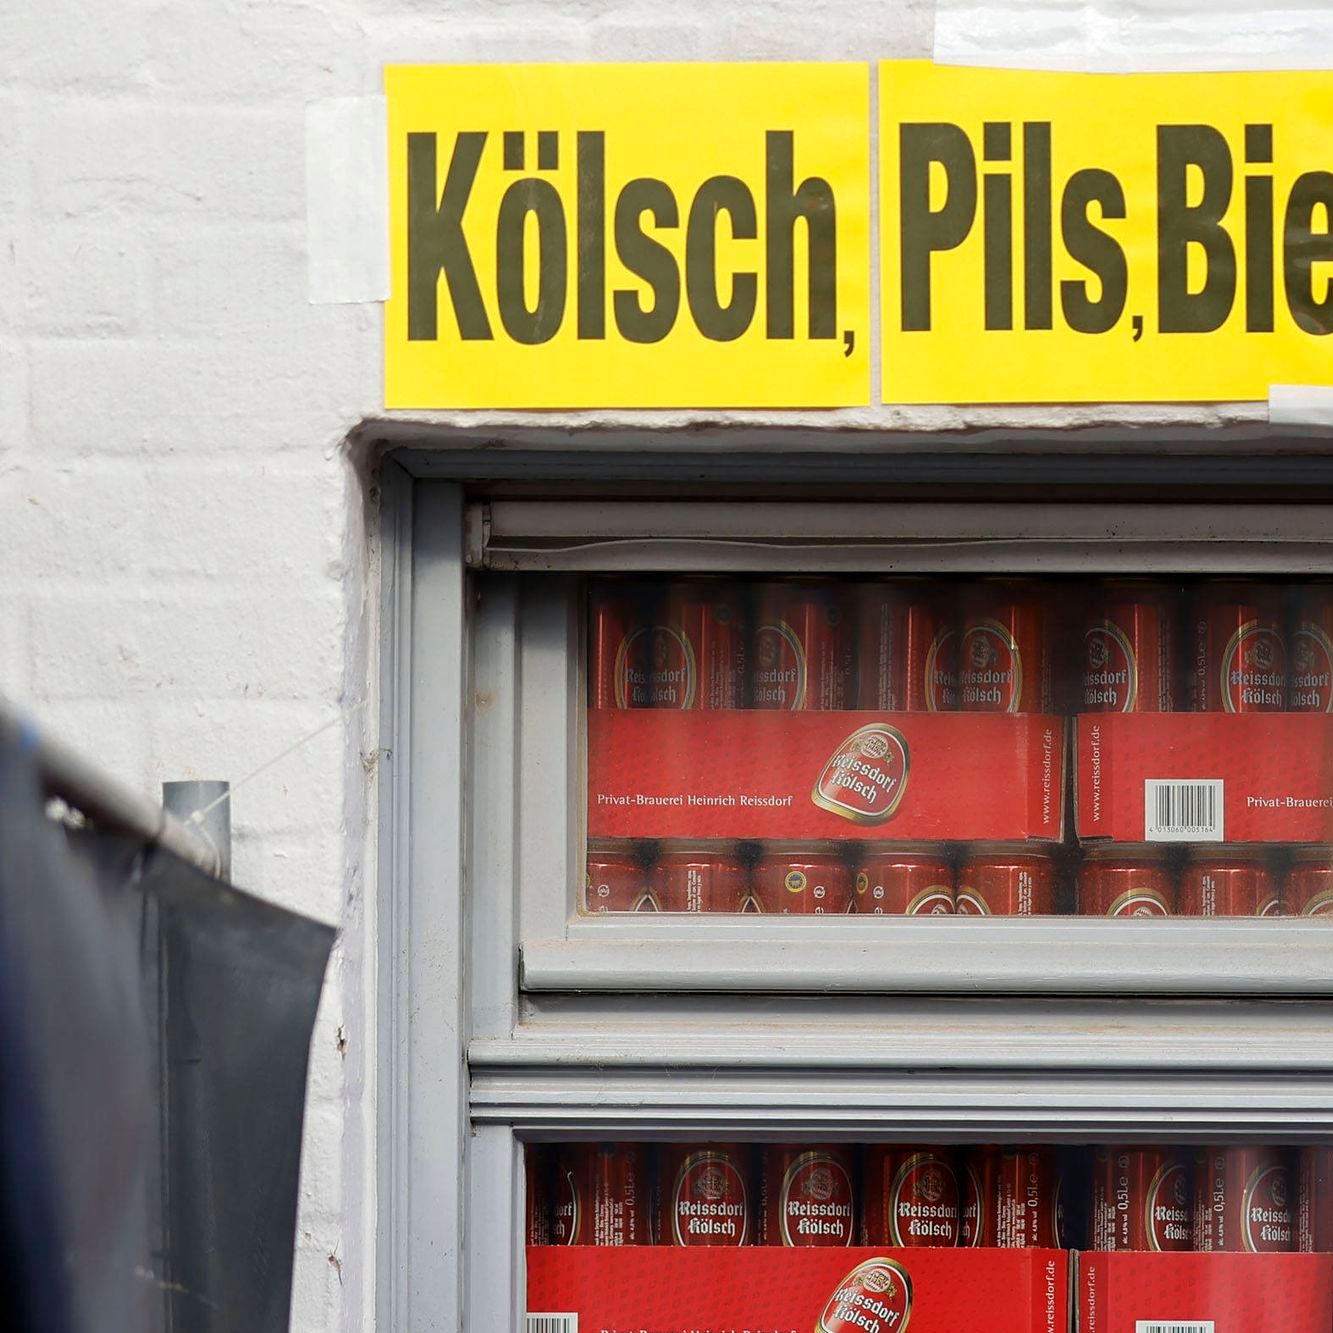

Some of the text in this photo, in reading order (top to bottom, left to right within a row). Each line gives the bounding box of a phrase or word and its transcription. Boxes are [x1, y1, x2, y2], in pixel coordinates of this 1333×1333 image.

[832, 752, 897, 791] Reissdorf
[1043, 729, 1052, 824] www.reissdorf.de
[1092, 726, 1101, 822] www.reissdorf.de
[598, 794, 792, 806] Privat-Brauerei Heinrich Reissdorf
[830, 771, 877, 804] Kölsch
[1247, 796, 1333, 809] Privat-Brauerei
[679, 1202, 744, 1218] Reissdorf
[688, 1218, 735, 1239] Kölsch
[797, 1218, 844, 1239] Kölsch
[836, 1286, 901, 1325] Reissdorf
